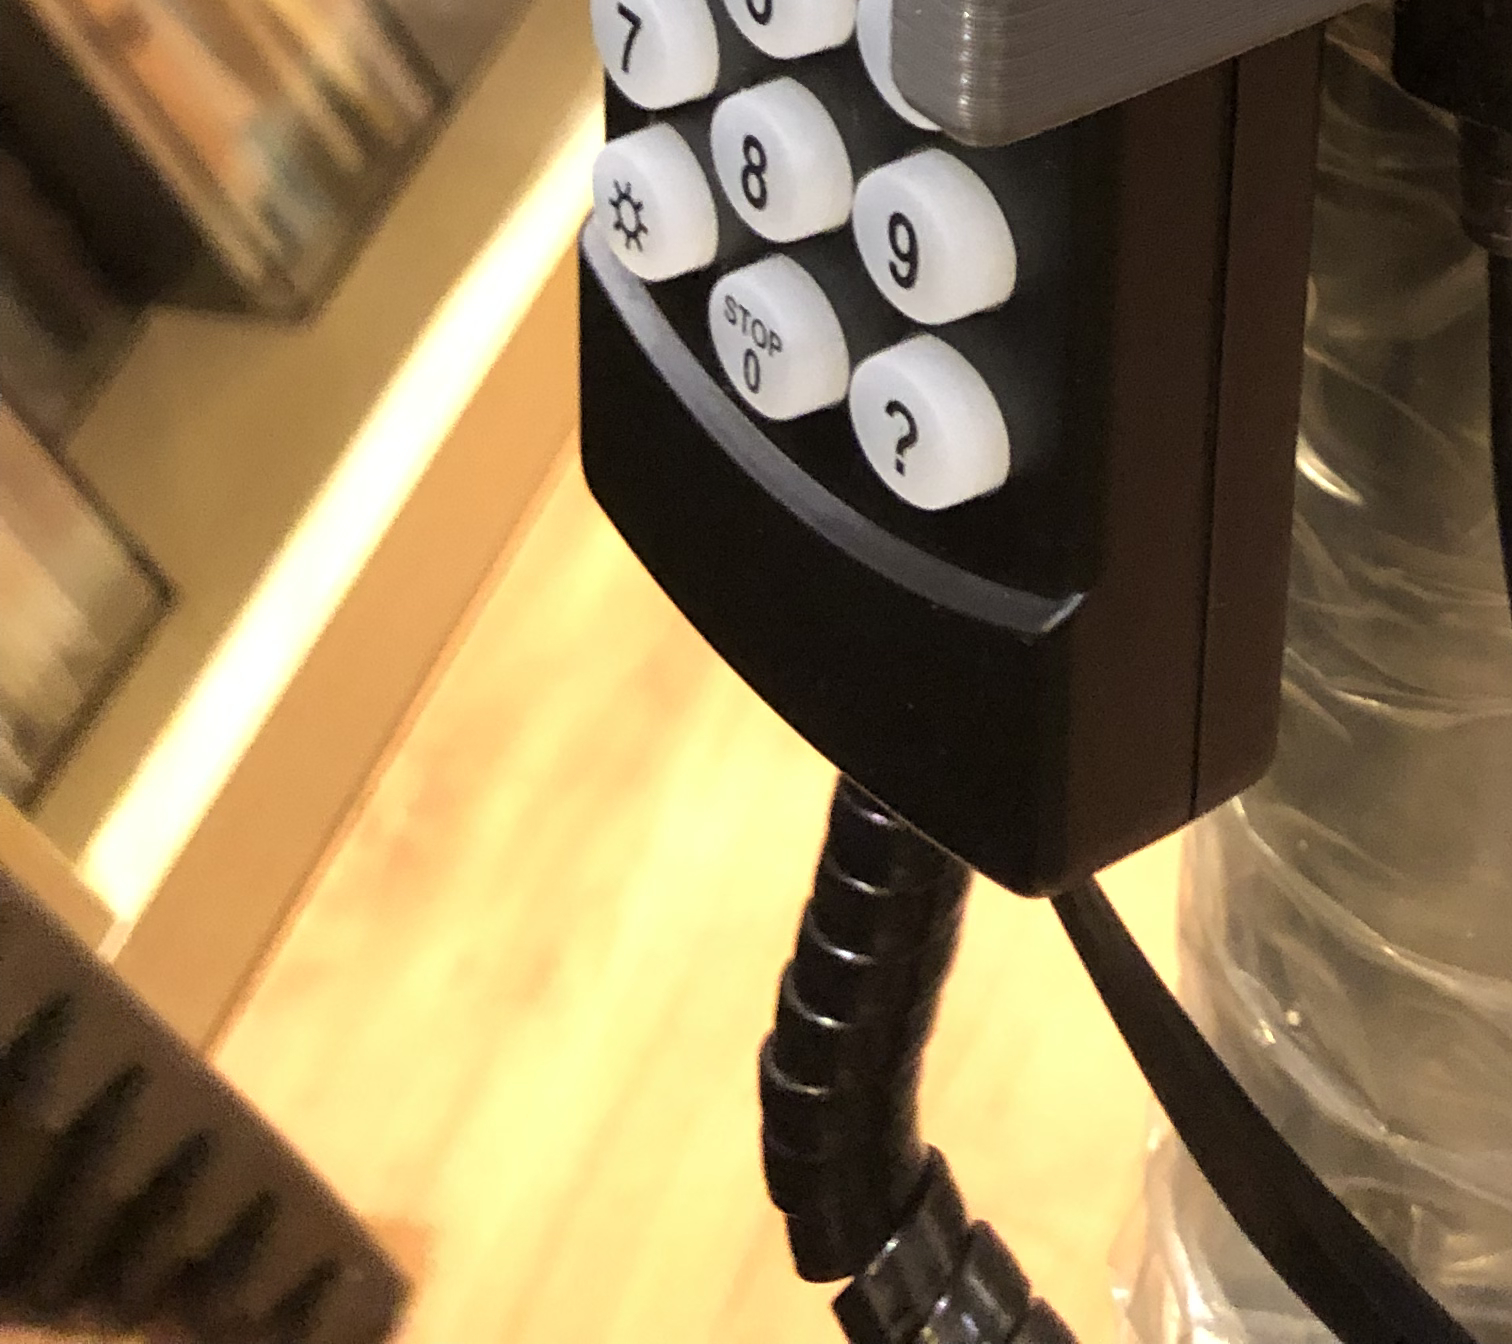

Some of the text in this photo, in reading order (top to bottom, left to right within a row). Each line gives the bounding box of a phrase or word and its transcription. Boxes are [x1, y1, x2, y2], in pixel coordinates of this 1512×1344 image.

[617, 2, 642, 74] 7
[741, 134, 768, 210] 8
[888, 211, 919, 290] 9
[723, 294, 783, 357] STOP
[743, 348, 761, 394] 0
[885, 399, 919, 476] ?
